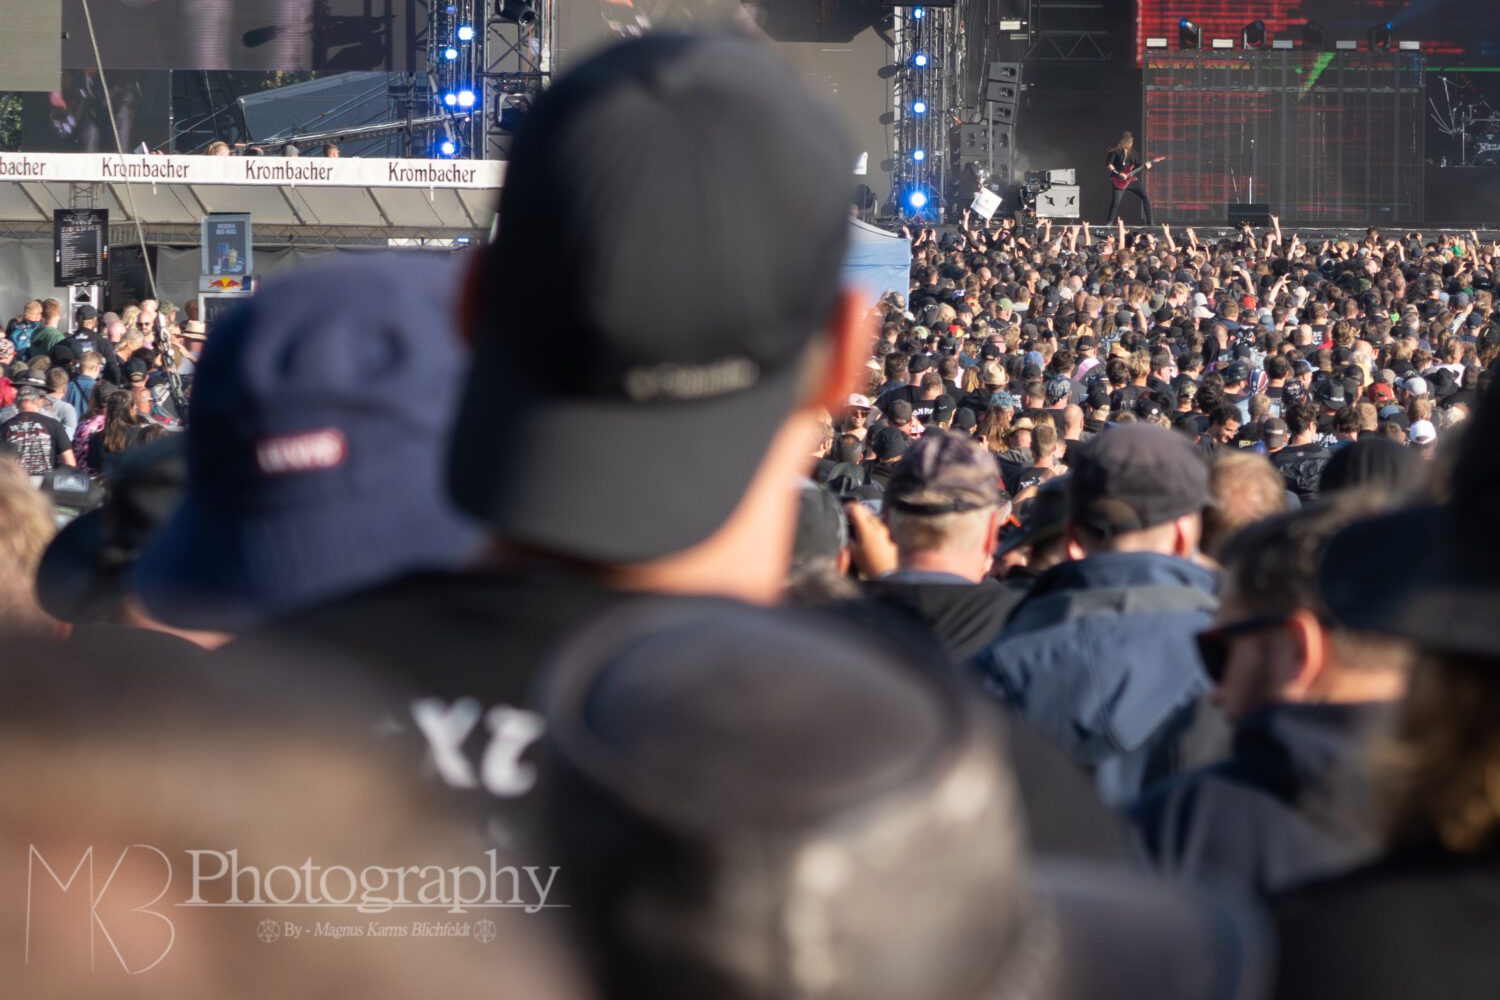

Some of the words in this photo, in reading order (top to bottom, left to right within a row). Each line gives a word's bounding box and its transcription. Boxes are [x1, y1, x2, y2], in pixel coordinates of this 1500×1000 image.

[102, 157, 190, 179] Krombacher
[245, 160, 333, 181] Krombacher
[388, 162, 477, 183] Krombacher
